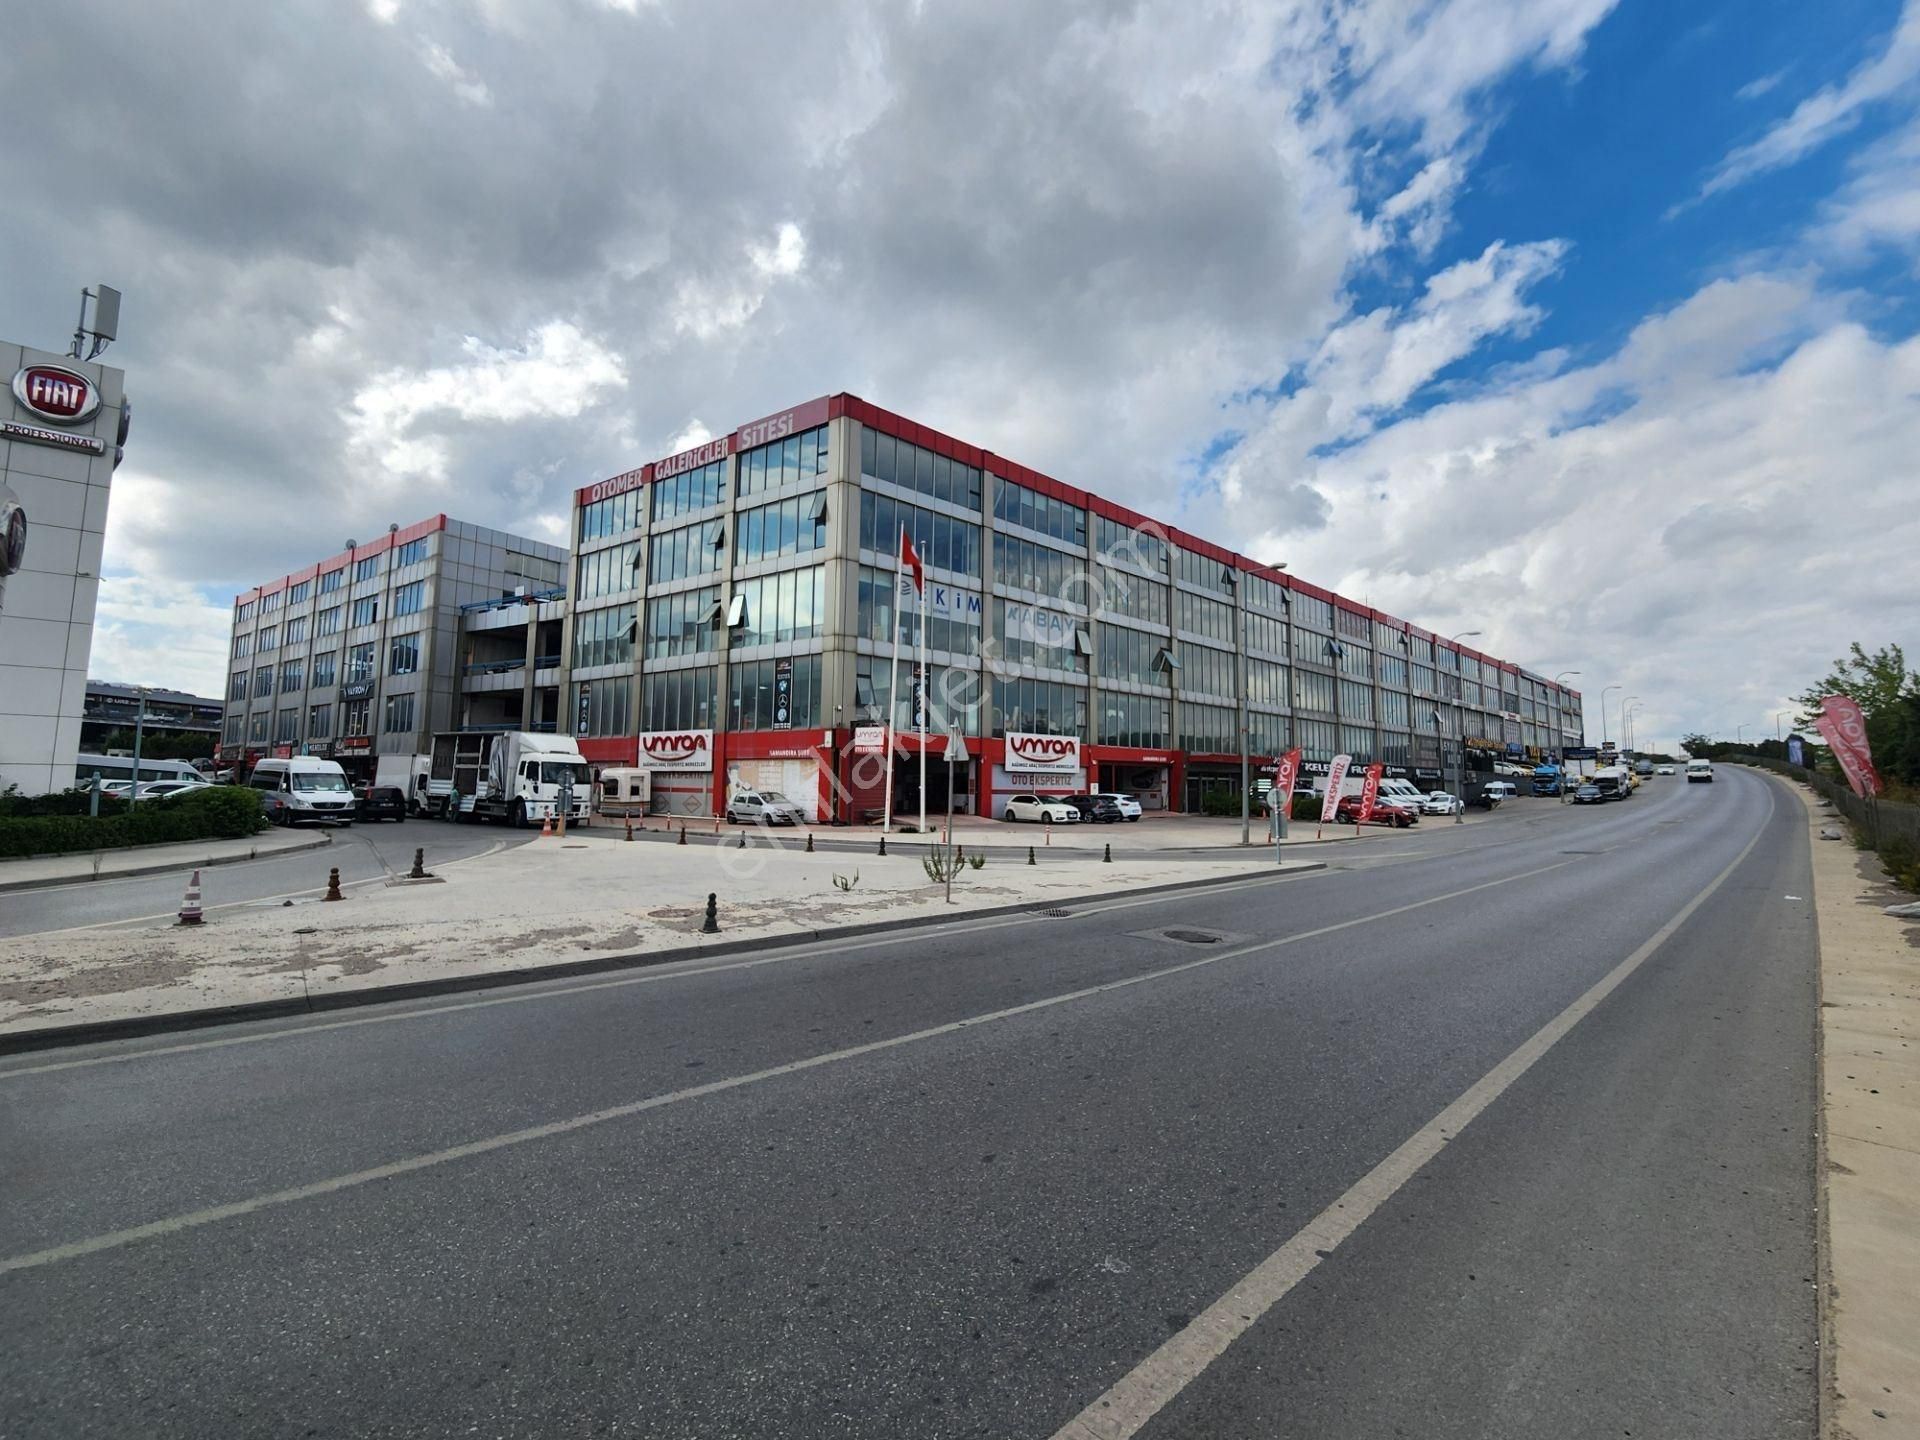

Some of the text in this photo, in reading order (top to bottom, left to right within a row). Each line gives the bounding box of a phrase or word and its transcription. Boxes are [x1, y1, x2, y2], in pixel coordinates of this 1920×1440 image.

[32, 376, 83, 409] FIAT
[5, 423, 100, 449] PROFESSIONAL
[591, 469, 642, 502] OTOMER
[1007, 606, 1075, 632] KABAY
[1012, 775, 1028, 785] OTO
